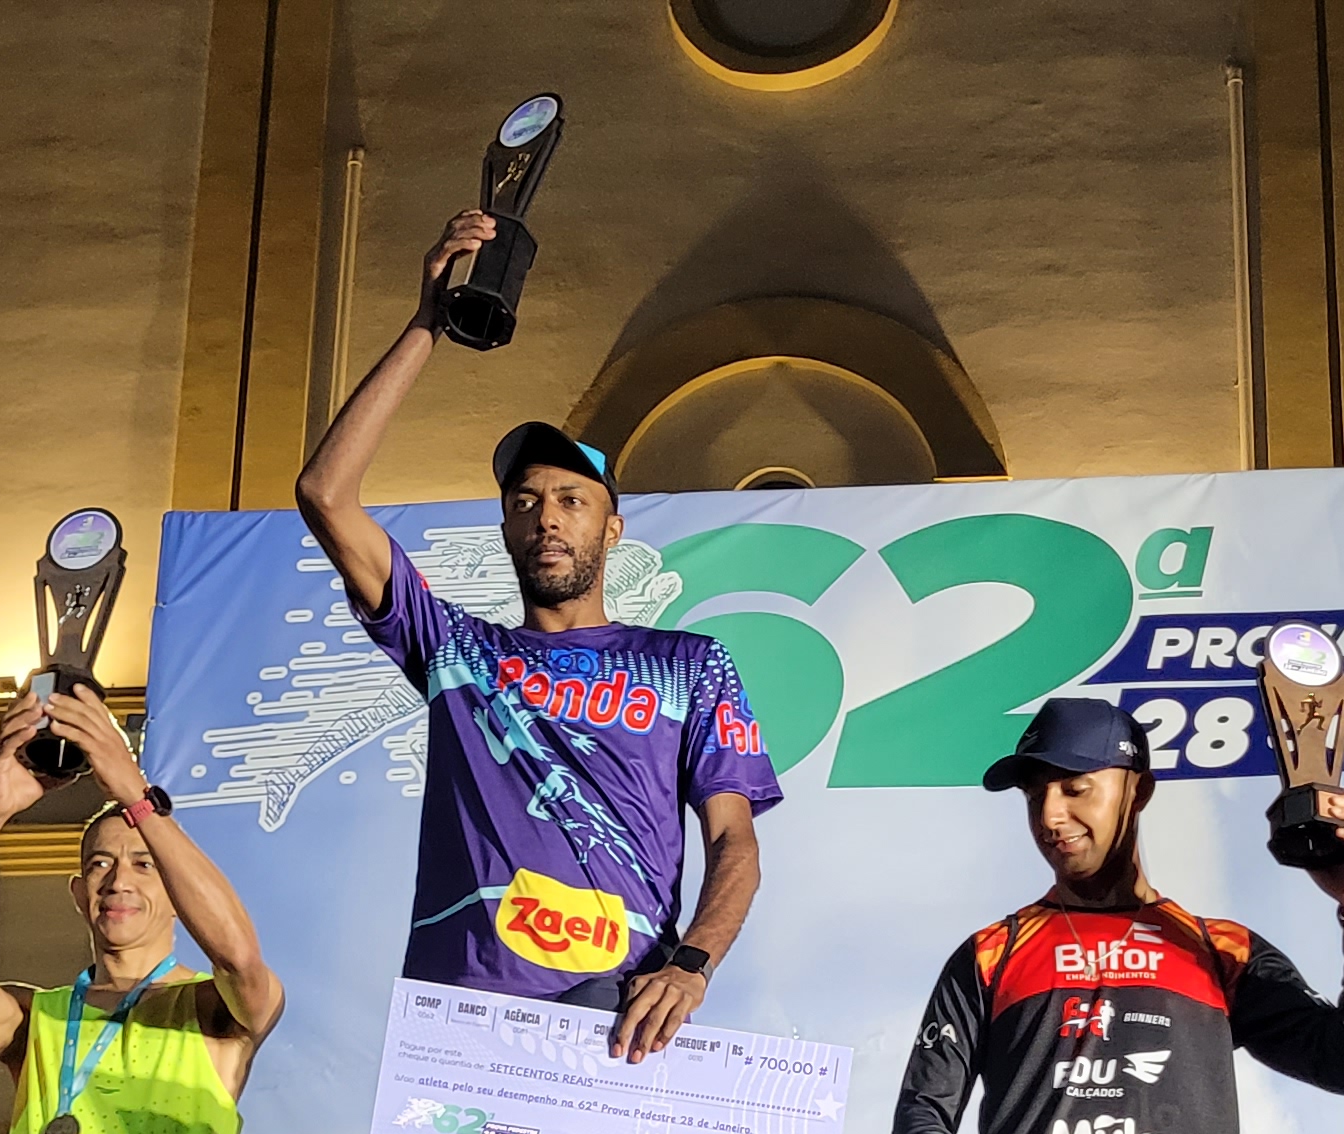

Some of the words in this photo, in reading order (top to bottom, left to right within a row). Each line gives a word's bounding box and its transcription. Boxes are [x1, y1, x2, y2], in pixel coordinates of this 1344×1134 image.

[495, 656, 658, 730] Panda
[1132, 697, 1253, 769] 28
[507, 898, 619, 953] Zaeli
[1055, 939, 1164, 973] Bilfor
[415, 995, 441, 1010] COMP
[458, 1002, 487, 1017] BANCO
[504, 1008, 540, 1025] AGÊNCIA
[559, 1019, 569, 1030] C1
[674, 1037, 707, 1052] CHEQUE
[1123, 1013, 1171, 1027] RUNNERS
[489, 1062, 558, 1082] SETECENTOS
[759, 1056, 814, 1076] 700,00
[418, 1076, 449, 1090] atleta
[453, 1082, 473, 1093] pelo
[477, 1086, 493, 1095] seu
[497, 1088, 557, 1106] desempenho
[561, 1098, 574, 1108] na
[578, 1100, 598, 1110] 62ª
[601, 1104, 630, 1117] Prova
[633, 1109, 676, 1125] Pedestre
[679, 1115, 694, 1126] 28
[697, 1118, 709, 1129] de
[712, 1120, 753, 1134] Janeiro.
[1066, 1087, 1124, 1099] CALÇADOS
